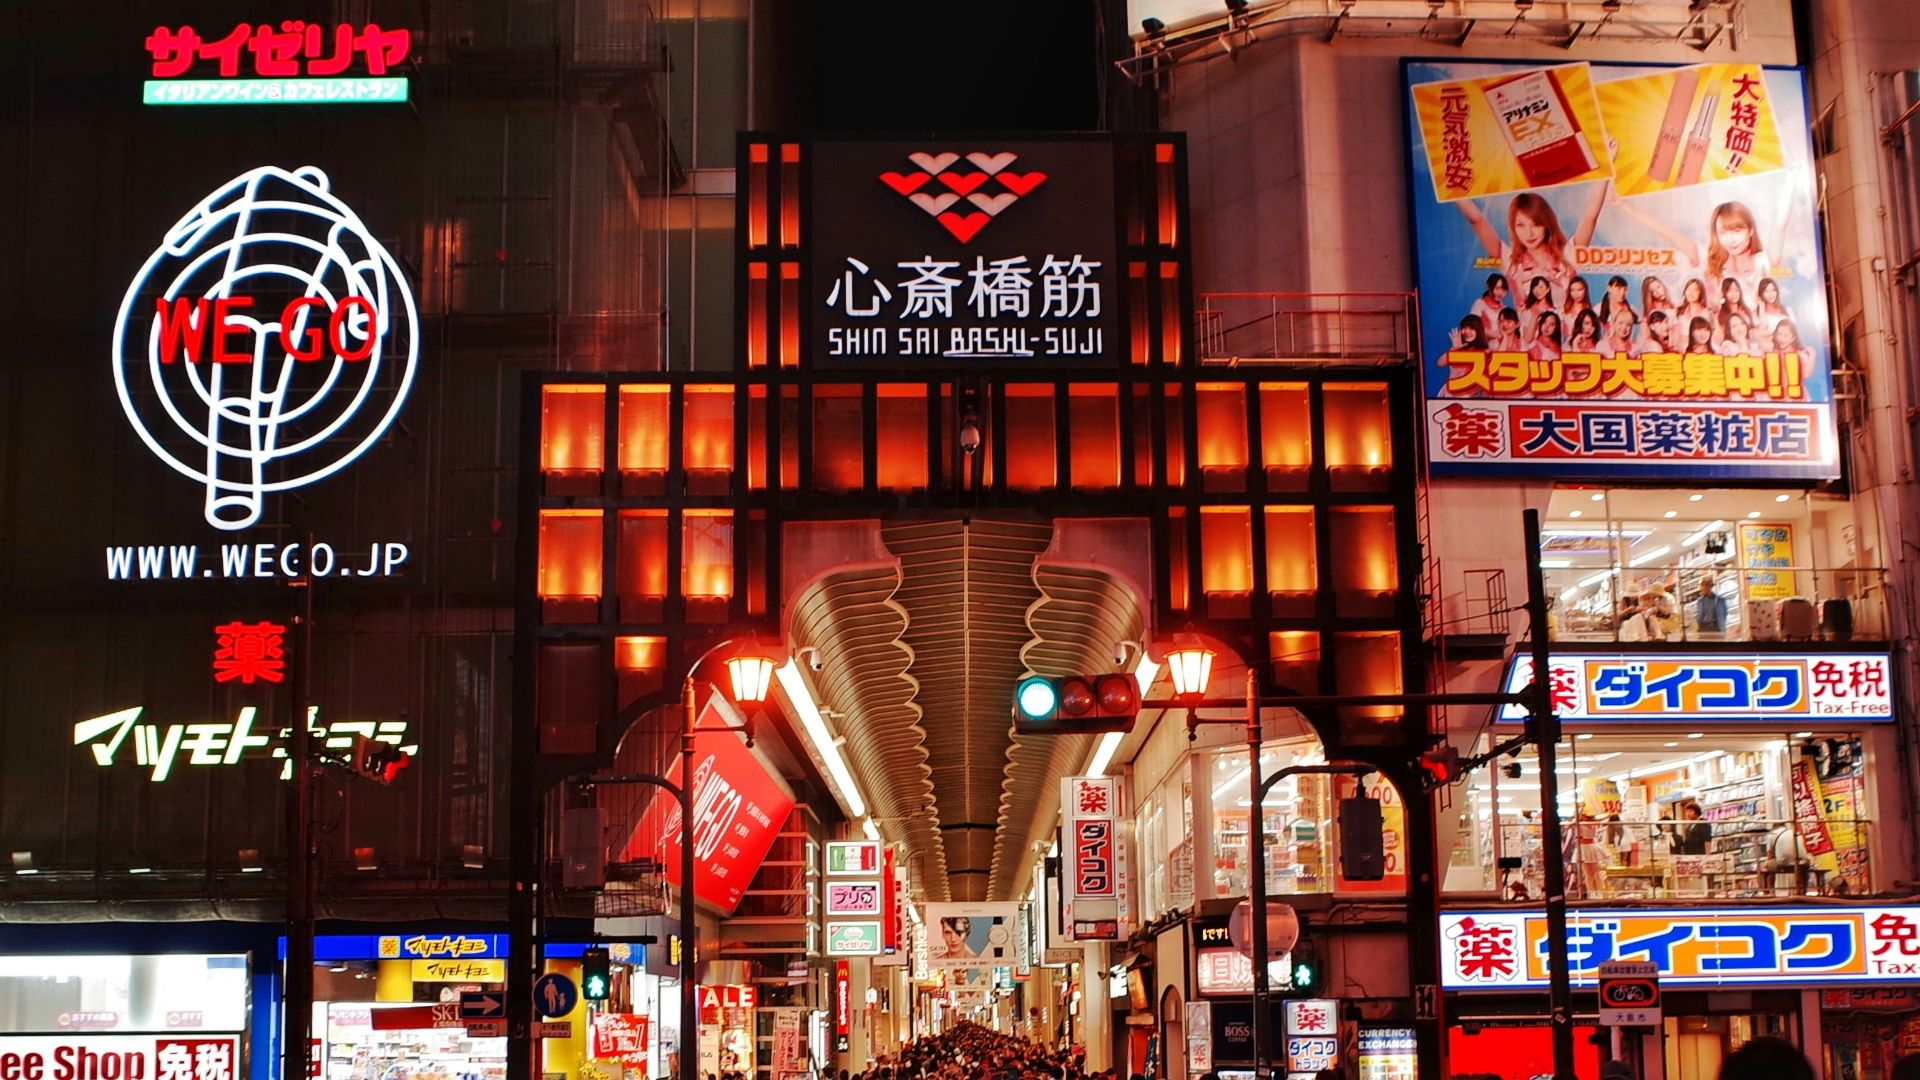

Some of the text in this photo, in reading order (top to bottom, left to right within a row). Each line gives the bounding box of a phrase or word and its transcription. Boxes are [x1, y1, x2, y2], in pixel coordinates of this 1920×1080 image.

[146, 20, 410, 77] サイゼリヤ
[1439, 87, 1473, 192] 元気激安
[1509, 110, 1557, 142] EX
[1726, 73, 1760, 174] 大特価!!
[1576, 246, 1676, 267] DDプリンセス
[826, 254, 1102, 319] 心斎橋筋
[157, 294, 377, 364] WE GO
[829, 327, 887, 355] SHIN
[899, 327, 939, 355] SAI
[1448, 351, 1803, 398] スタッフ大募集中!!
[1444, 403, 1502, 456] 薬
[1521, 411, 1810, 456] 大国薬粧店
[106, 542, 409, 580] WWW.WEGO.JP
[213, 621, 286, 684] 薬
[1594, 664, 1800, 708] ダイコク
[1811, 660, 1887, 698] 免税
[1813, 701, 1889, 714] Tax-Free
[675, 770, 743, 862] WEGO
[1080, 781, 1108, 813] 薬
[1081, 821, 1107, 892] ダイコク
[406, 936, 487, 957] マツモトキヨシ
[914, 926, 928, 979] Bershka
[1459, 917, 1514, 978] 薬
[1534, 922, 1855, 973] ダイコク
[1870, 913, 1920, 956] 免
[427, 963, 489, 979] マツモトキヨシ
[432, 1005, 463, 1021] SK-I
[702, 987, 754, 1009] ALE
[1296, 999, 1328, 1031] 薬
[1224, 1025, 1250, 1037] BOSS
[1358, 1028, 1412, 1039] CURRENCY
[1358, 1039, 1414, 1050] EXCHANGE
[53, 1045, 145, 1080] Shop
[158, 1043, 230, 1080] 免税
